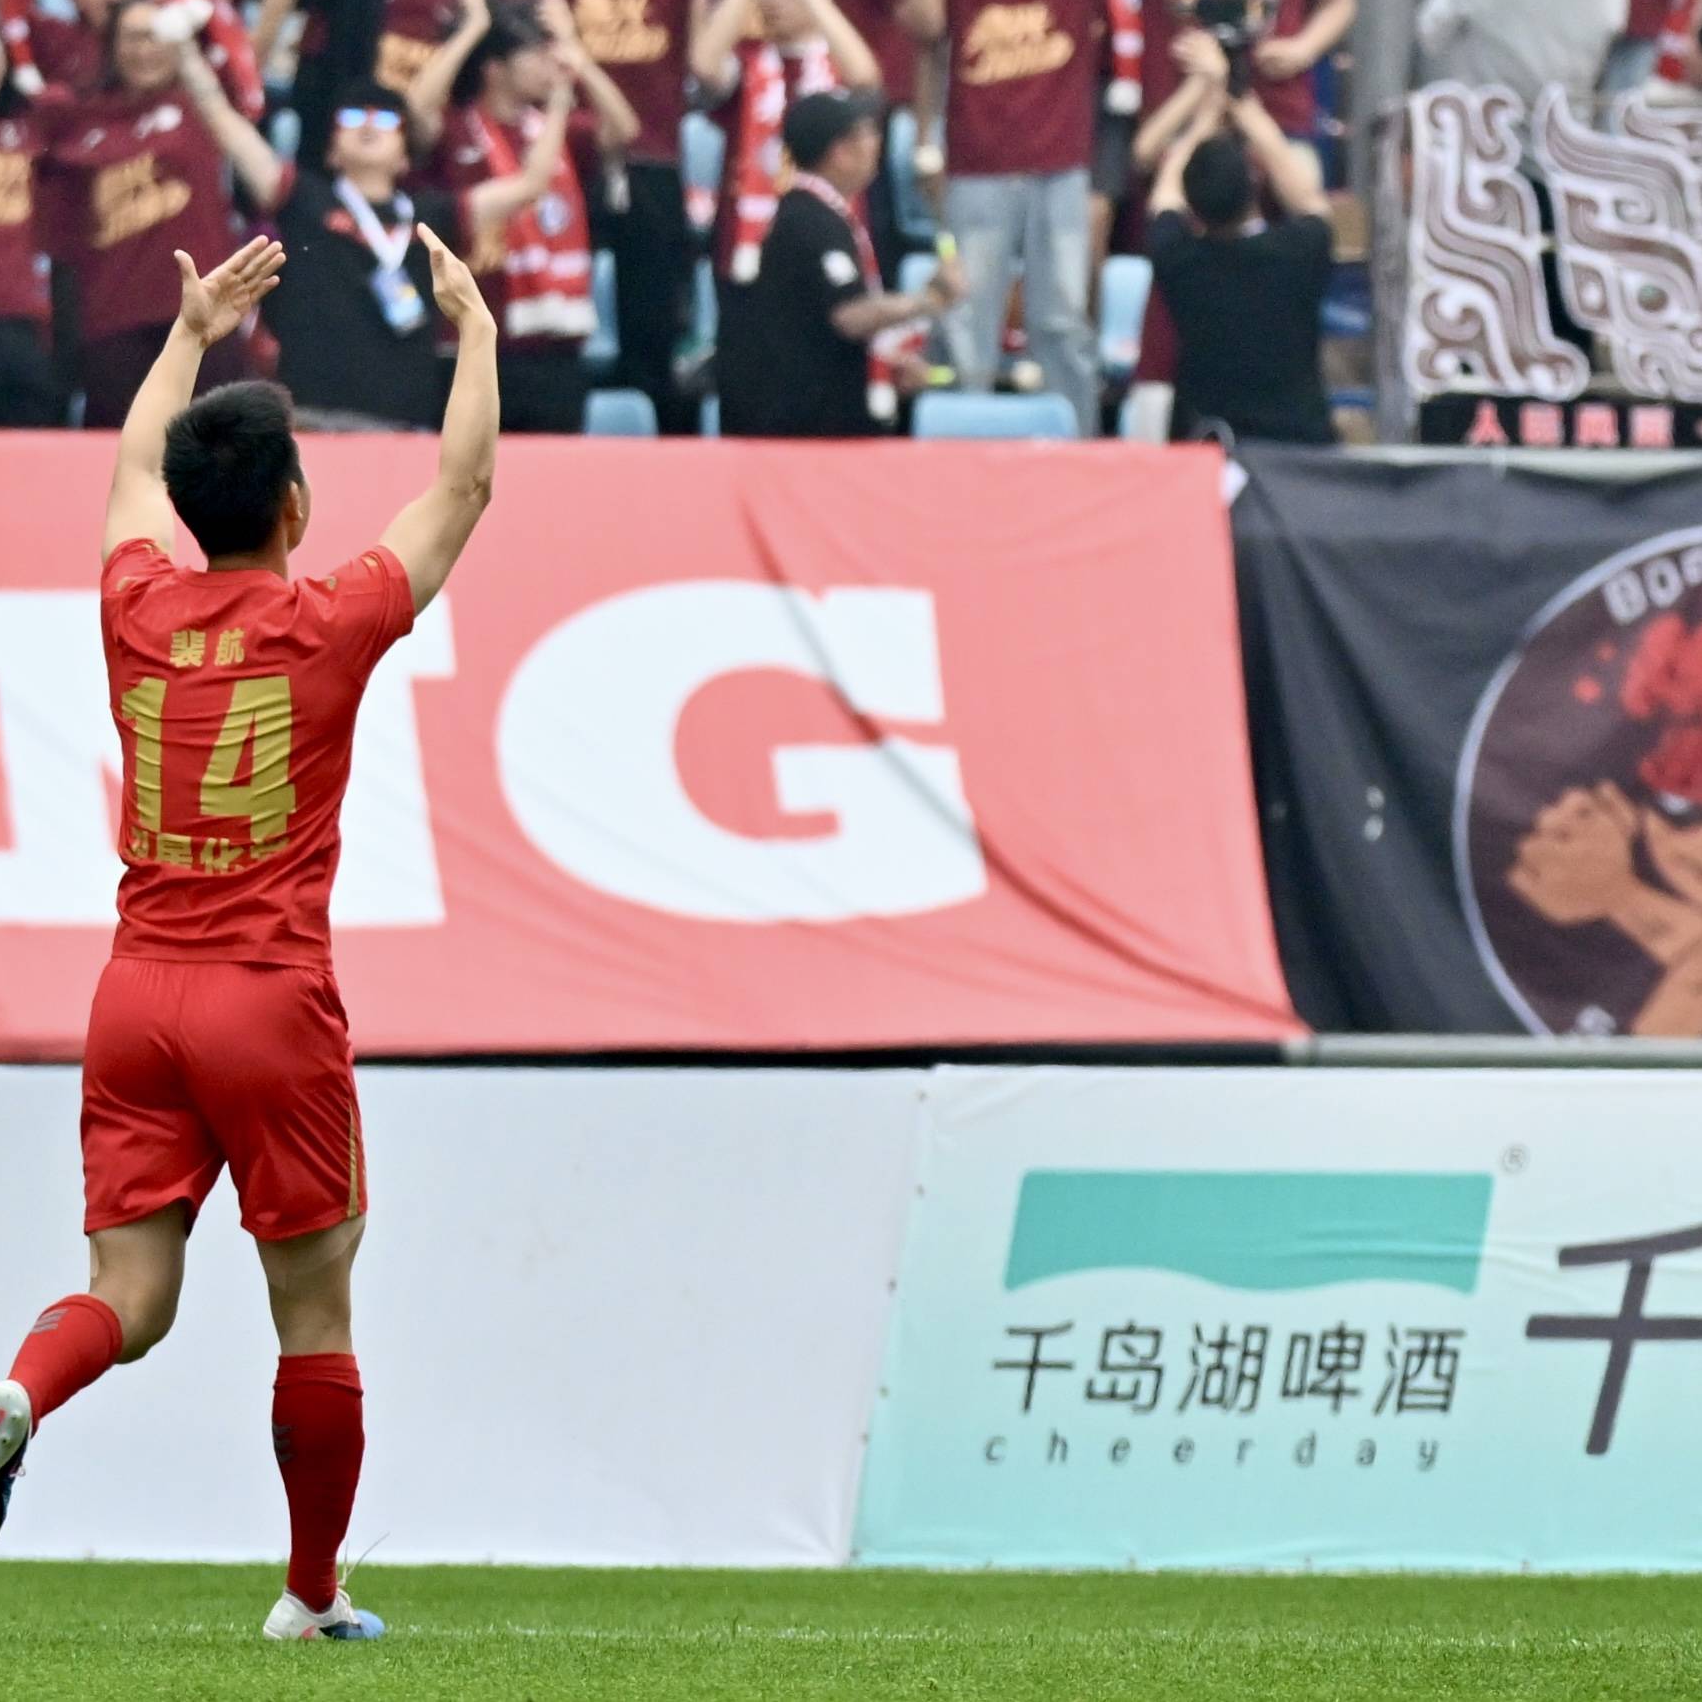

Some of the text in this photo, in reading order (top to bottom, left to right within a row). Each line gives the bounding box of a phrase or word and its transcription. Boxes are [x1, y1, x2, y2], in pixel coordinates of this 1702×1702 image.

[121, 675, 297, 845] 14
[990, 1319, 1466, 1416] 千岛湖啤酒
[983, 1430, 1442, 1470] cheerday
